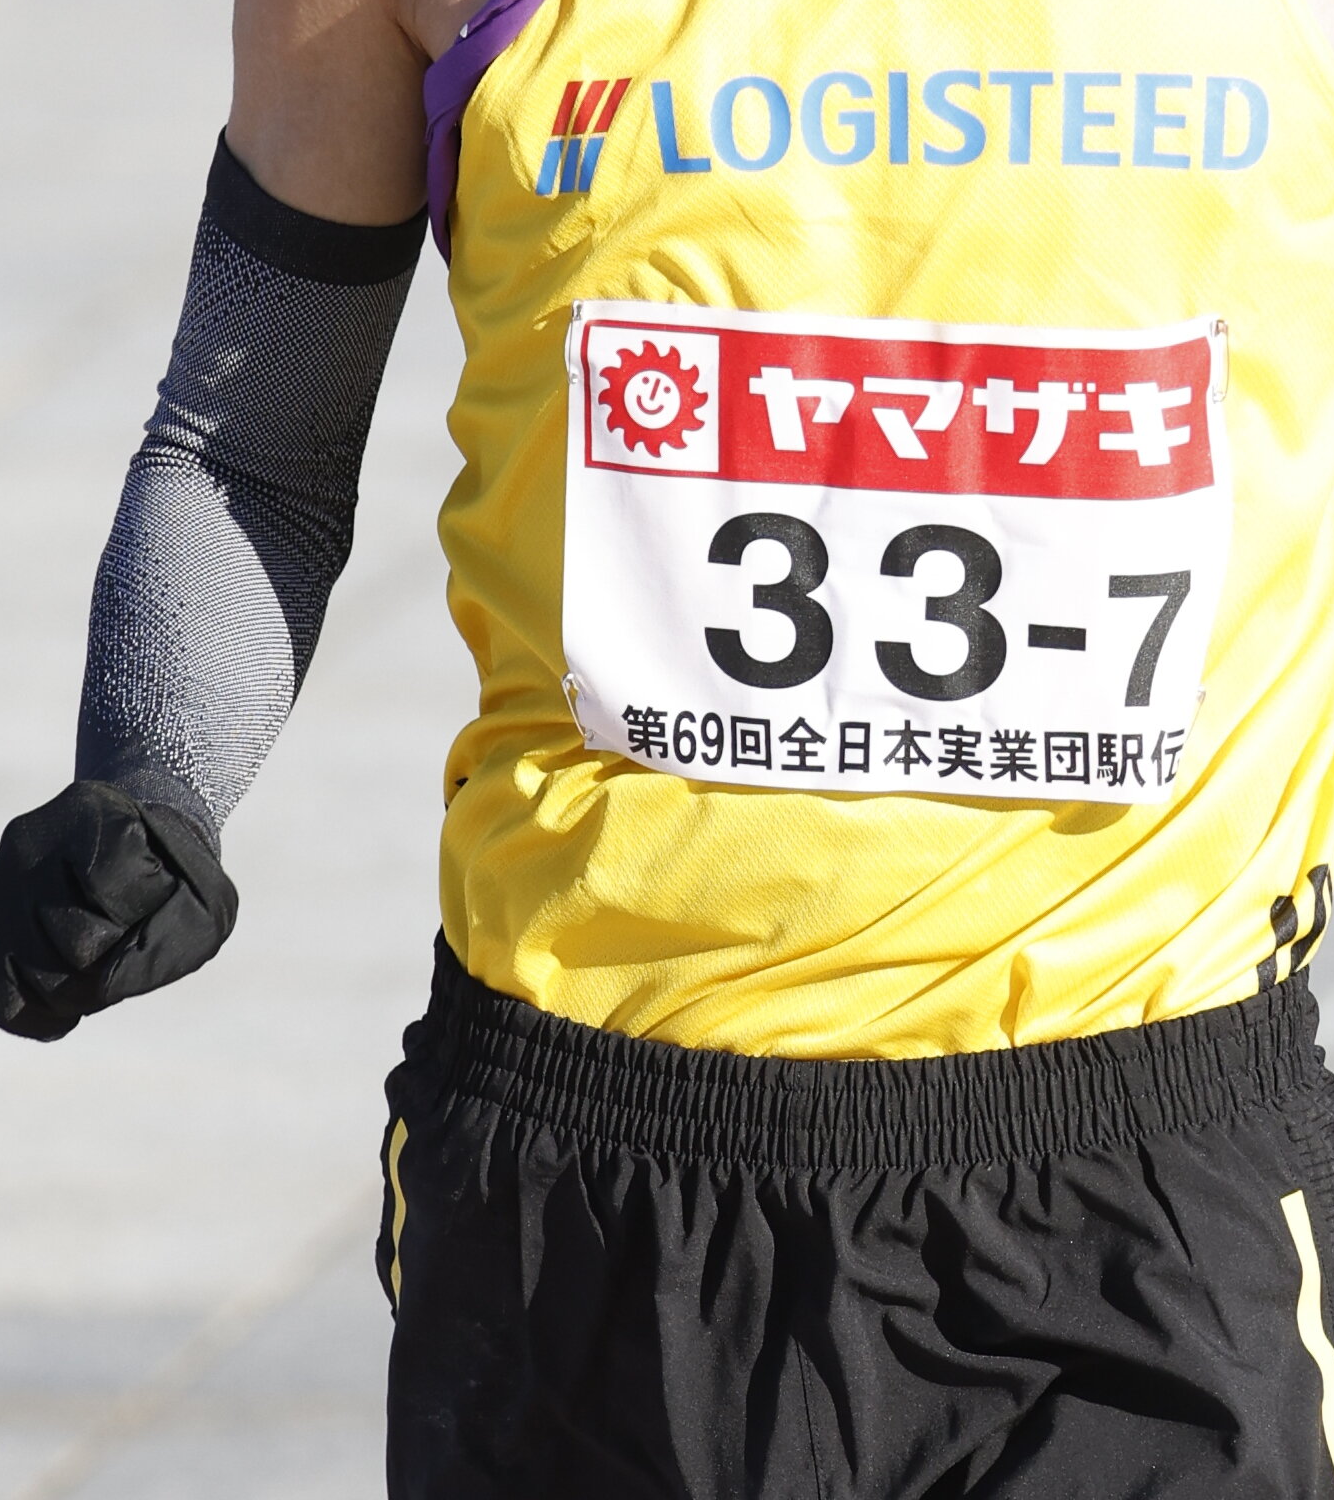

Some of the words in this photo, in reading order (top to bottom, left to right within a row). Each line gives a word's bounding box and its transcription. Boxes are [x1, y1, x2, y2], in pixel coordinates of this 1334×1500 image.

[650, 70, 1268, 173] LOGISTEED
[750, 367, 1192, 466] ヤマザキ
[704, 513, 1192, 707] 33-7
